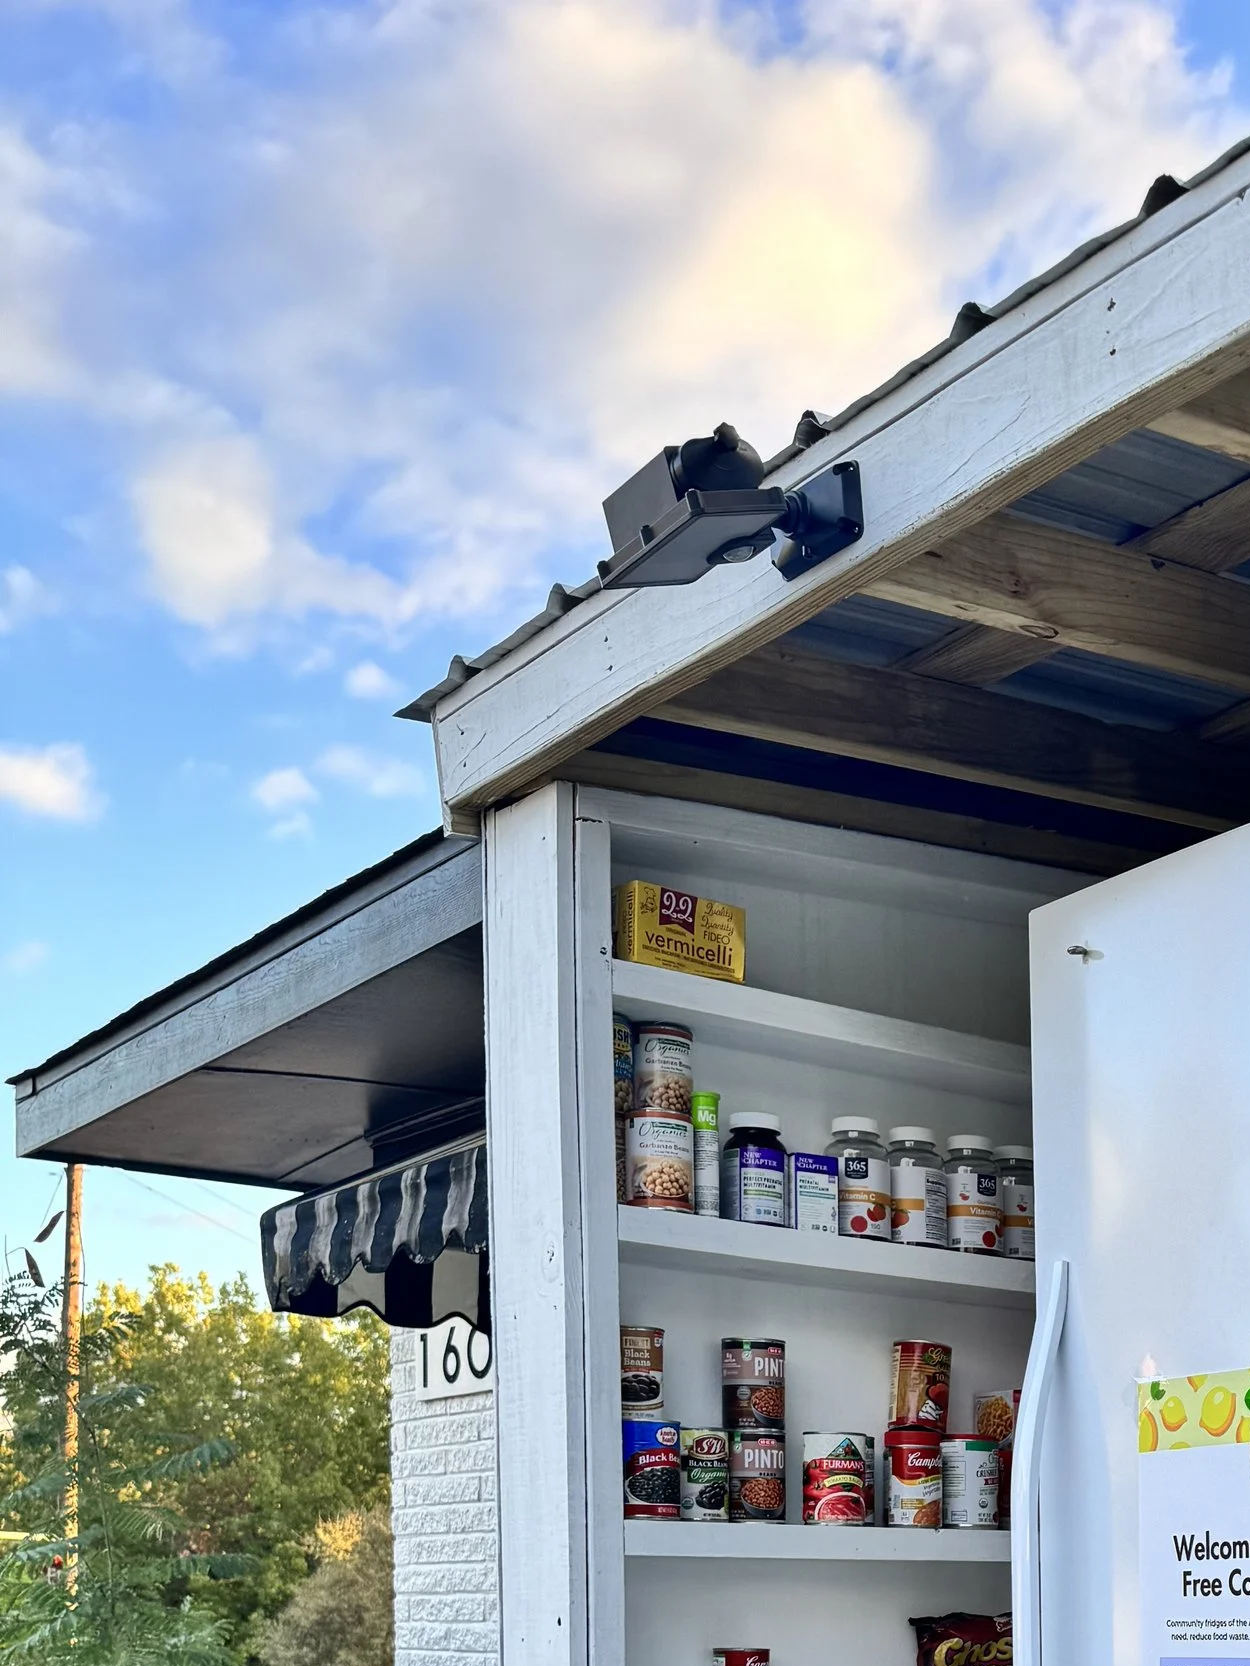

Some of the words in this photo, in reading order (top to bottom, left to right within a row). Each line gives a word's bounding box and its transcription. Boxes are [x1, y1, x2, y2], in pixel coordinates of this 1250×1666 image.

[704, 902, 733, 920] Quality
[704, 931, 730, 945] FIDEO
[645, 931, 732, 966] vermicelli
[645, 1039, 690, 1056] Organics
[698, 1110, 716, 1126] Mg
[639, 1122, 687, 1140] Organics
[640, 1142, 672, 1150] Garbanzo
[847, 1161, 866, 1172] 365
[979, 1178, 995, 1189] 365
[970, 1208, 995, 1217] Vitamin
[420, 1325, 493, 1388] 160
[625, 1350, 650, 1359] Black
[624, 1359, 650, 1367] Beans
[754, 1357, 784, 1377] PINT
[639, 1453, 667, 1465] Black
[689, 1459, 712, 1467] BLACK
[744, 1450, 784, 1468] PINTO
[1182, 1570, 1222, 1597] Free
[1166, 1619, 1204, 1630] Community
[1205, 1619, 1227, 1630] fridges
[1228, 1619, 1235, 1627] of
[1236, 1619, 1247, 1627] the
[1171, 1634, 1188, 1643] need,
[1189, 1633, 1212, 1641] reduce
[1213, 1633, 1227, 1641] food
[1229, 1633, 1249, 1643] waste,
